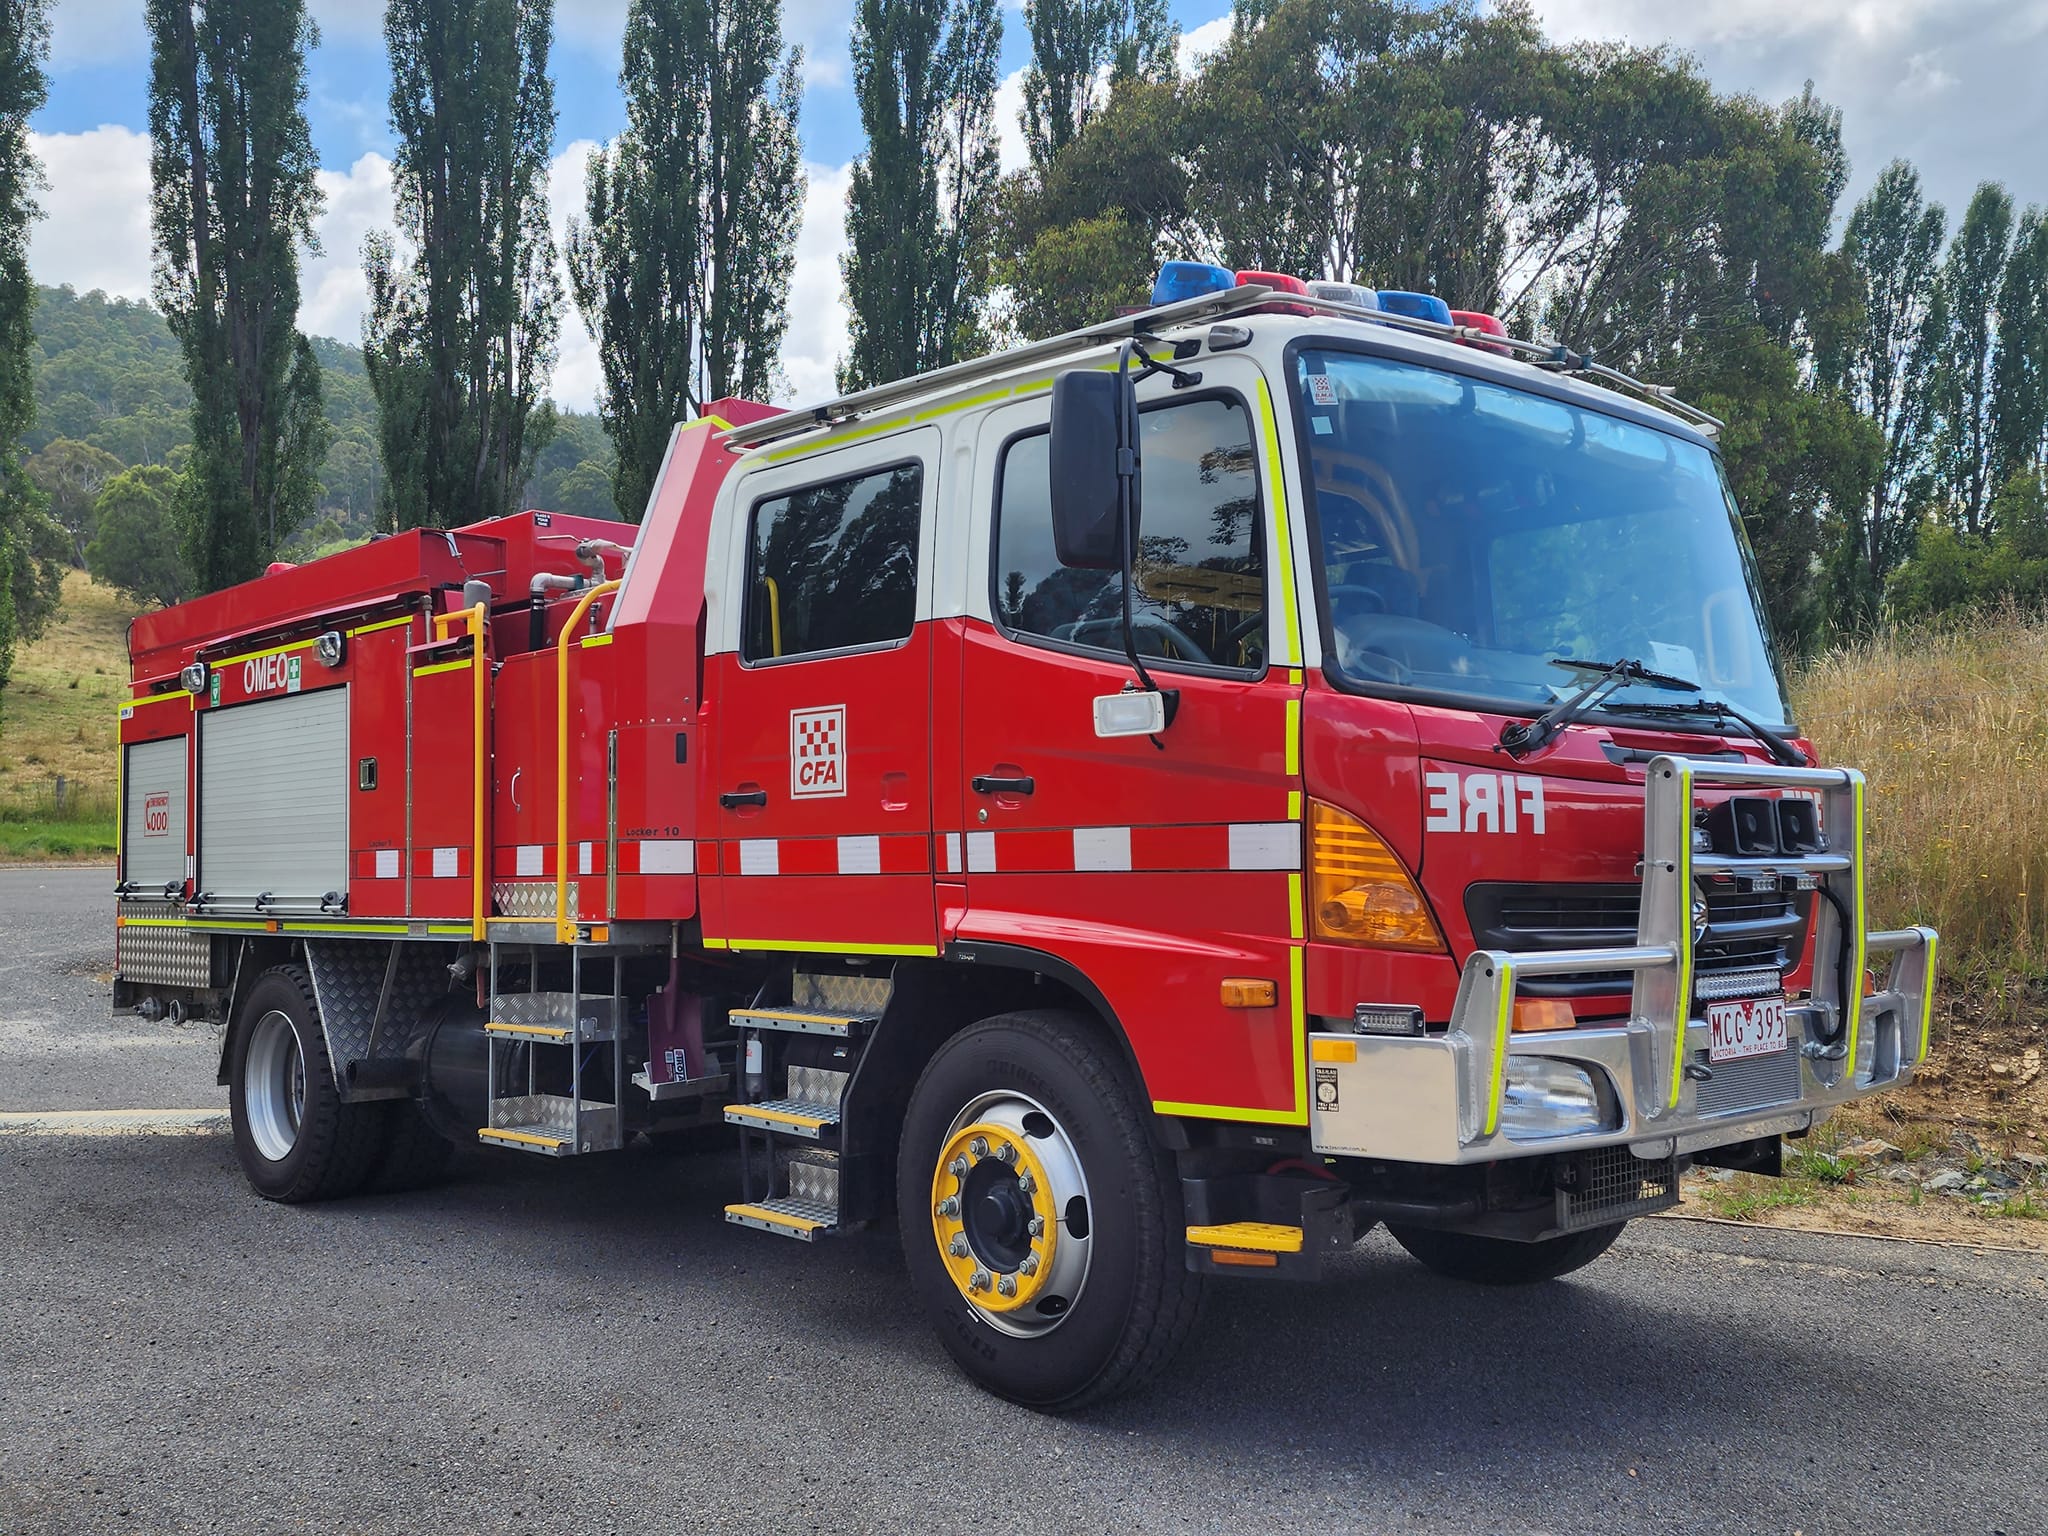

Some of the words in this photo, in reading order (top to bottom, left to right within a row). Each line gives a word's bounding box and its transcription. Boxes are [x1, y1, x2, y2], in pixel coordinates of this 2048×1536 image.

[244, 653, 288, 694] OMEO
[799, 760, 837, 786] CFA
[151, 811, 168, 831] 000
[626, 827, 659, 837] Locker
[664, 826, 680, 836] 10
[1711, 1011, 1744, 1048] MCG
[1755, 1005, 1784, 1041] 395
[1713, 1047, 1737, 1058] VICTORIA
[1743, 1044, 1753, 1054] THE
[1754, 1042, 1769, 1052] PLACE
[1769, 1041, 1777, 1050] TO
